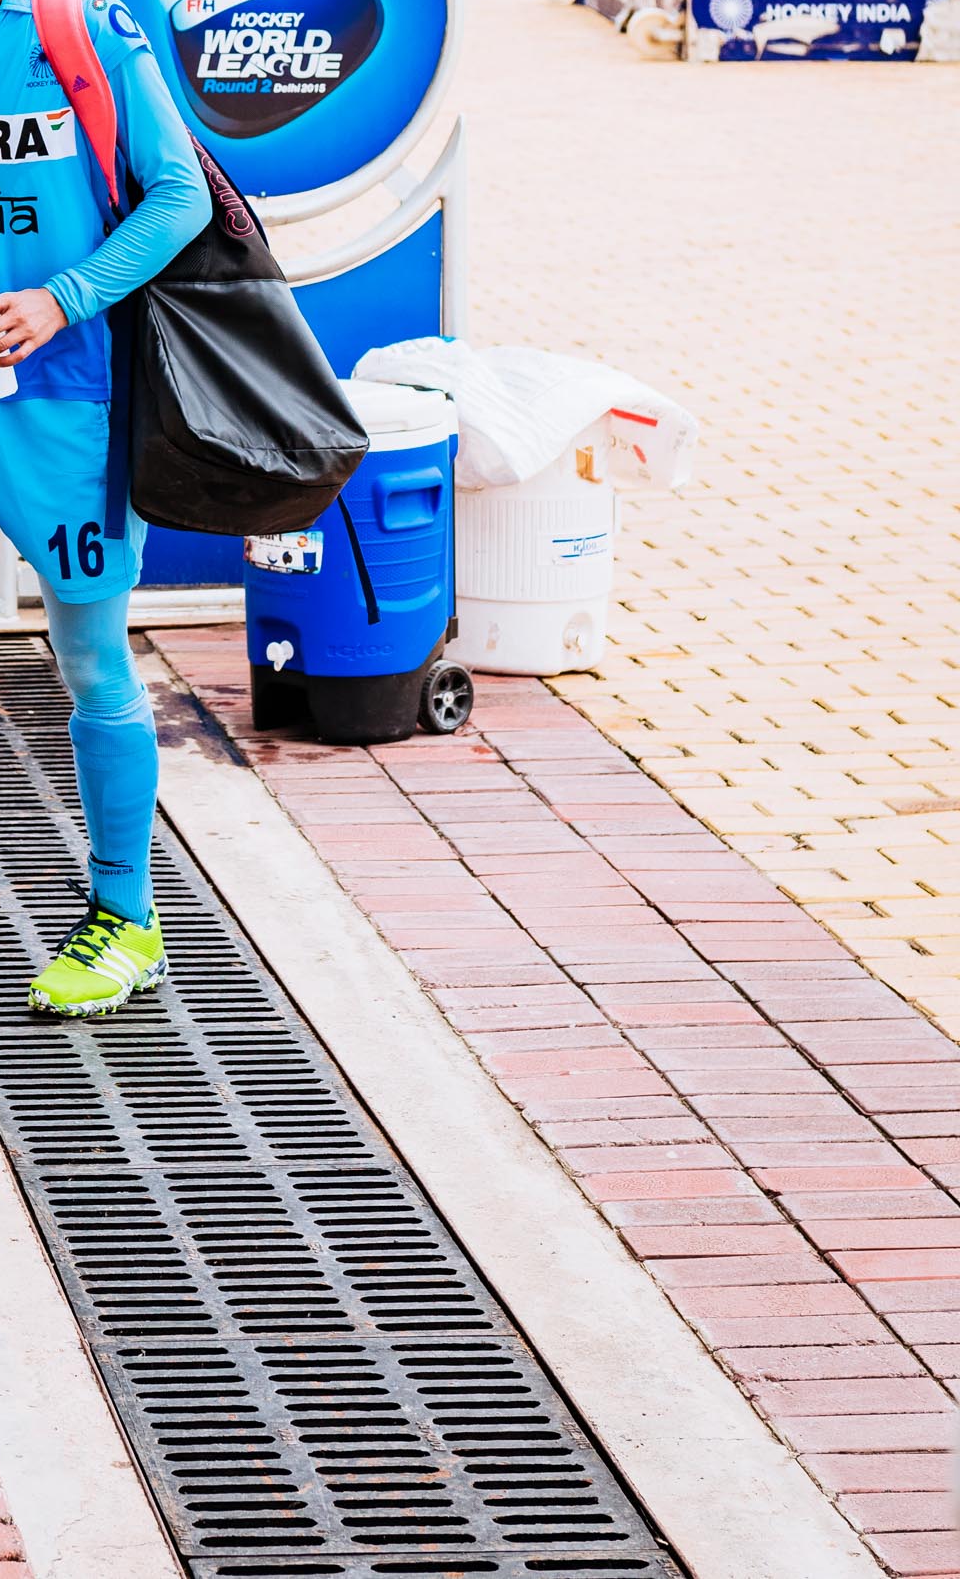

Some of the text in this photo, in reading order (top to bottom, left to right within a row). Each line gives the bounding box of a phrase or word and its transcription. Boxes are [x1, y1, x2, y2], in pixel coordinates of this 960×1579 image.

[231, 12, 305, 28] HOCKEY
[765, 3, 912, 23] HOCKEY INDIA
[203, 29, 333, 55] WORLD
[196, 53, 343, 79] LEAGUE
[202, 79, 258, 94] Round
[260, 79, 274, 94] 2
[47, 521, 105, 580] 16
